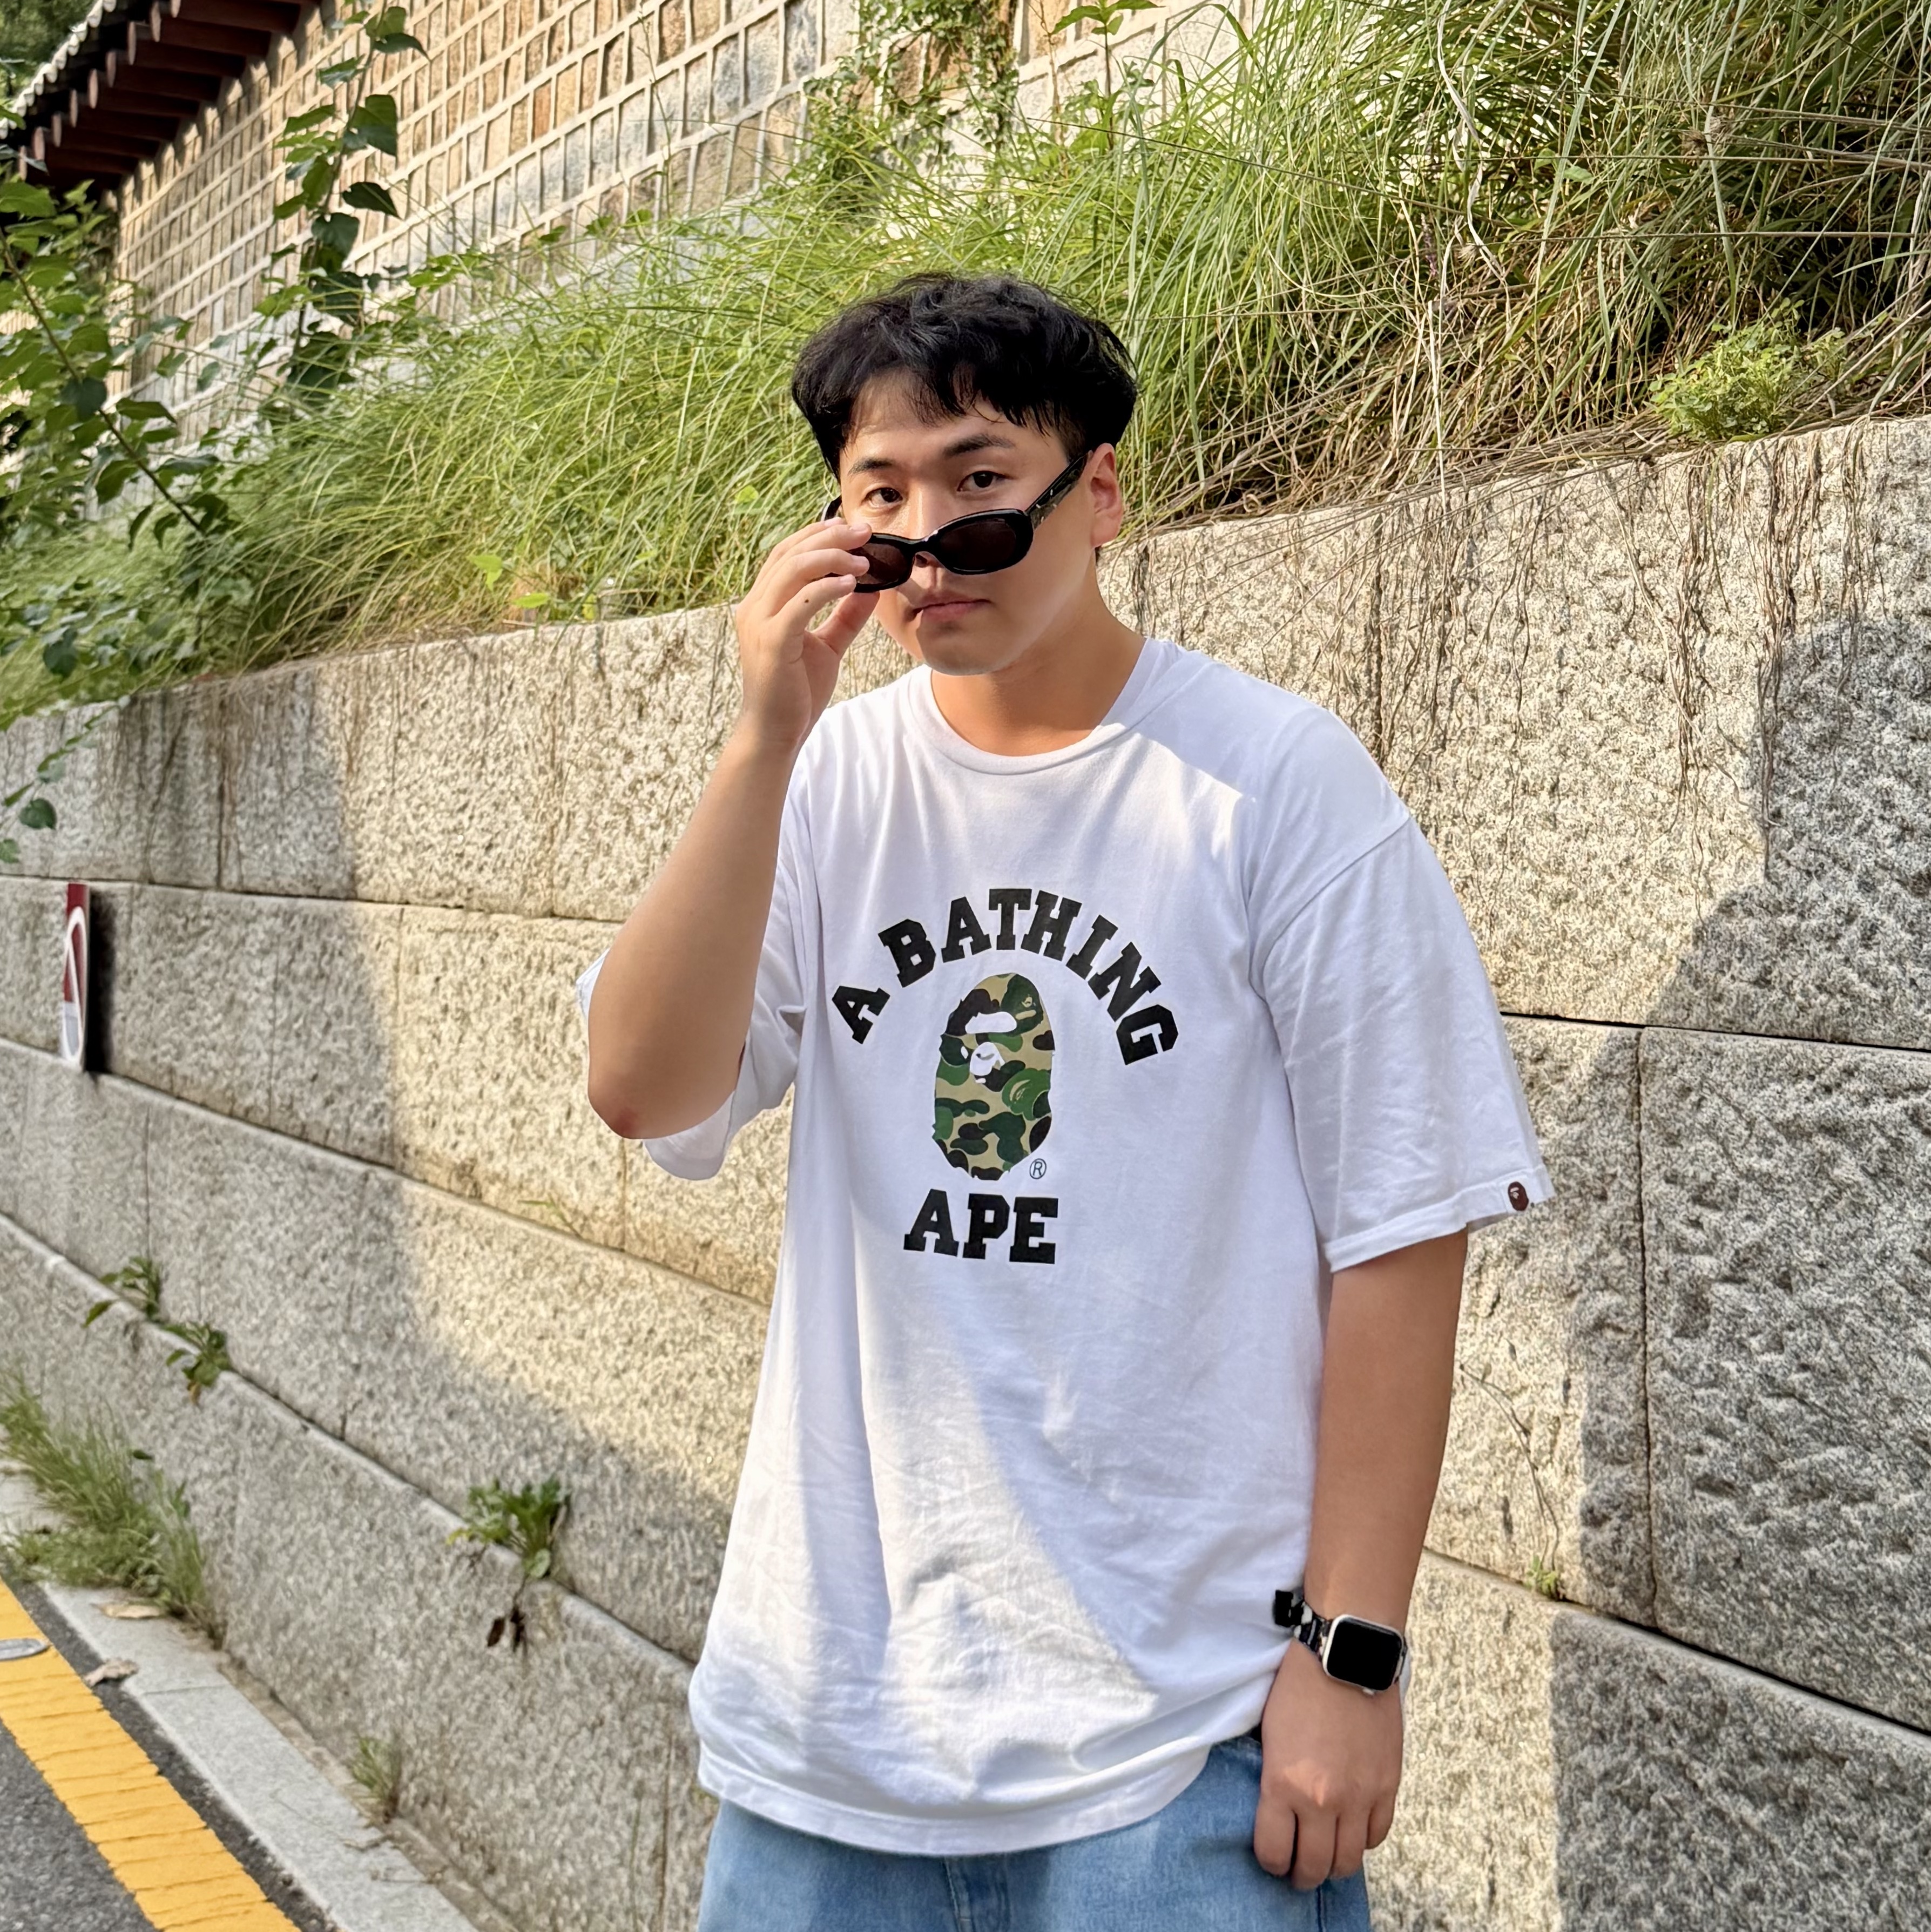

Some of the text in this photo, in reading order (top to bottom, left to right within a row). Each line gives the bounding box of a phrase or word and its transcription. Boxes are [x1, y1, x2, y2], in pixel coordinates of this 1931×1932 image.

[832, 888, 1179, 1066] A BATHING
[903, 1188, 1059, 1265] APE
